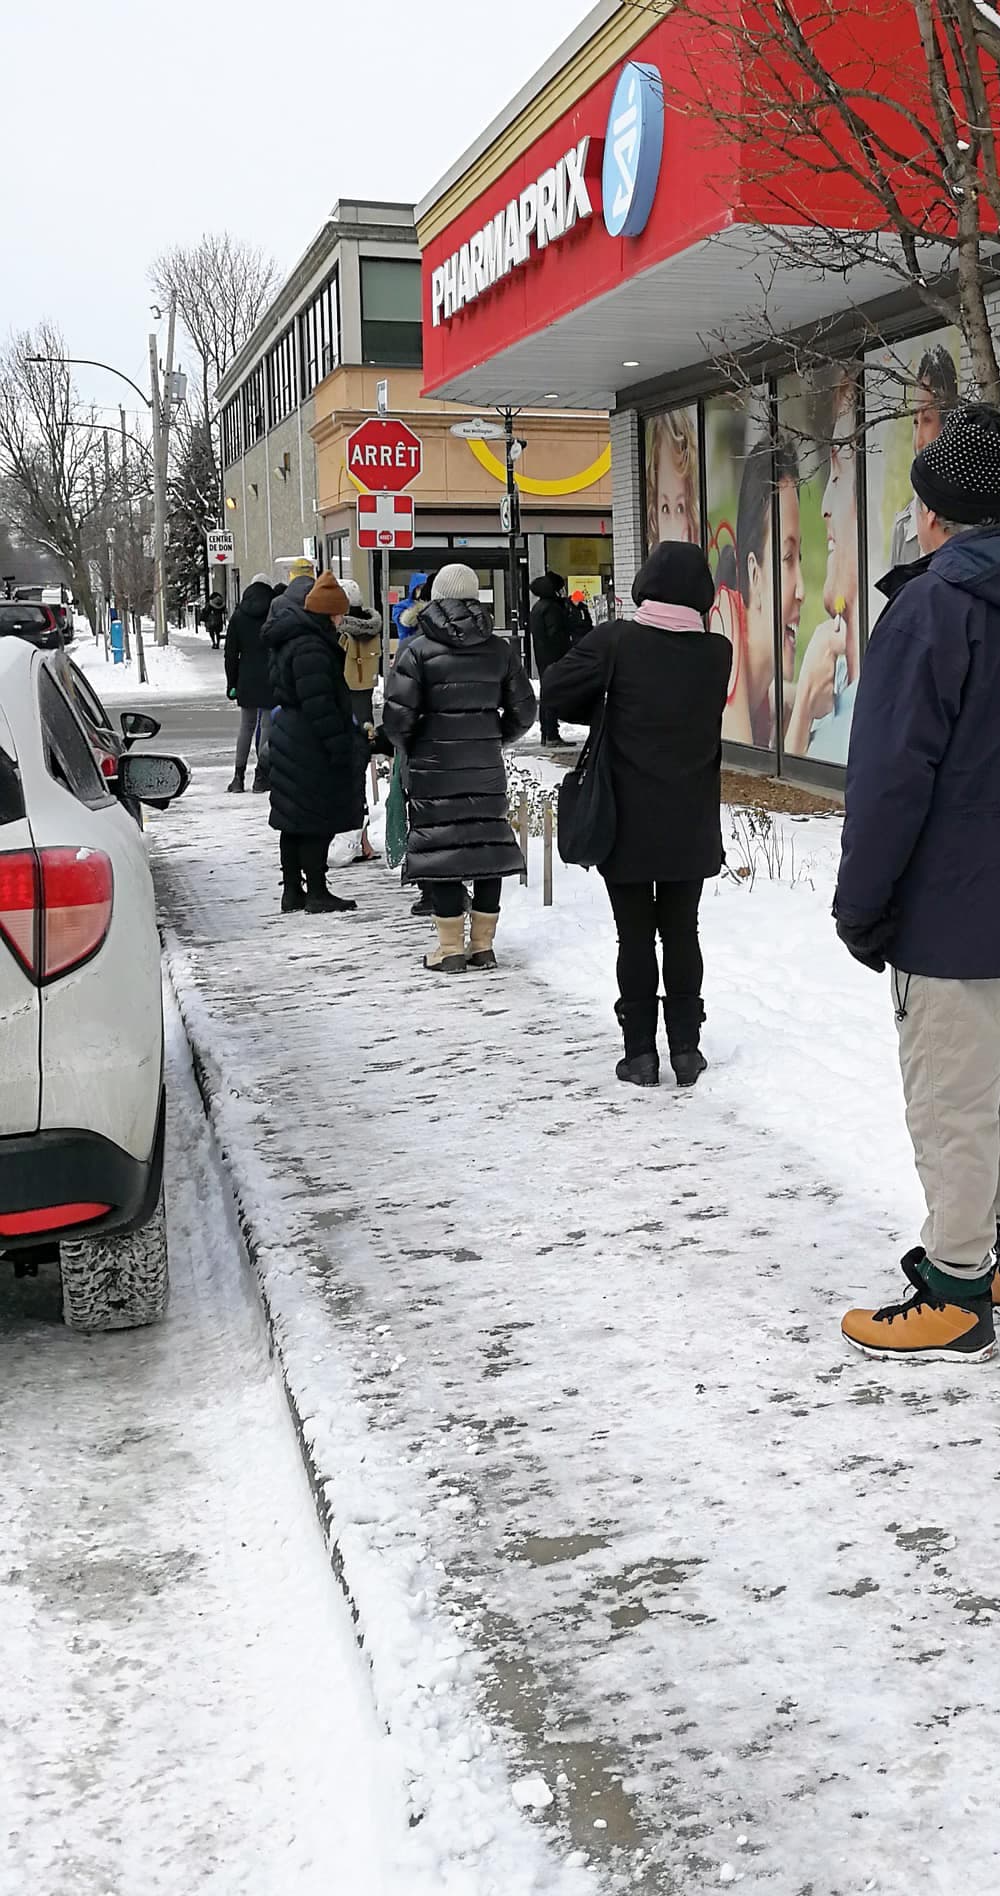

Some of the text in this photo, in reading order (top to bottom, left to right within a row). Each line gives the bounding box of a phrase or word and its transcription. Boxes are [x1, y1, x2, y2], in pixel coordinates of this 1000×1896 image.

[431, 135, 593, 327] PHARMAPRIX
[351, 441, 419, 467] ARRÊT
[209, 535, 232, 543] CENTRE
